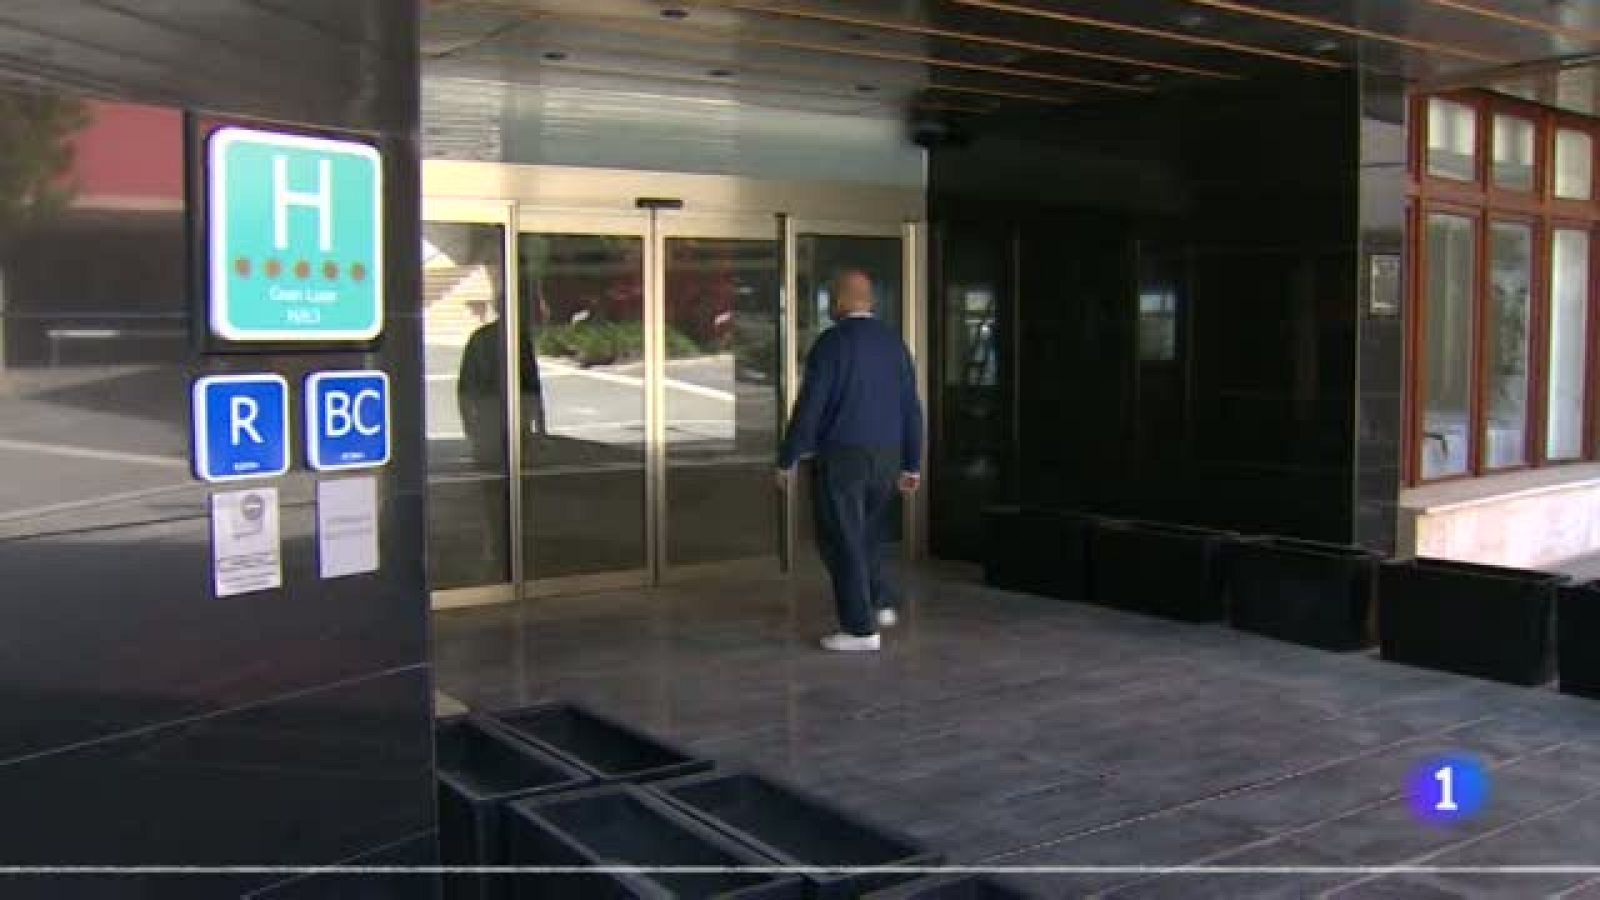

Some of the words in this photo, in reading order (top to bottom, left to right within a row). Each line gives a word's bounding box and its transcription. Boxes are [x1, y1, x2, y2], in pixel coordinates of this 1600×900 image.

[273, 155, 331, 250] H
[230, 396, 264, 446] R
[325, 389, 381, 437] BC
